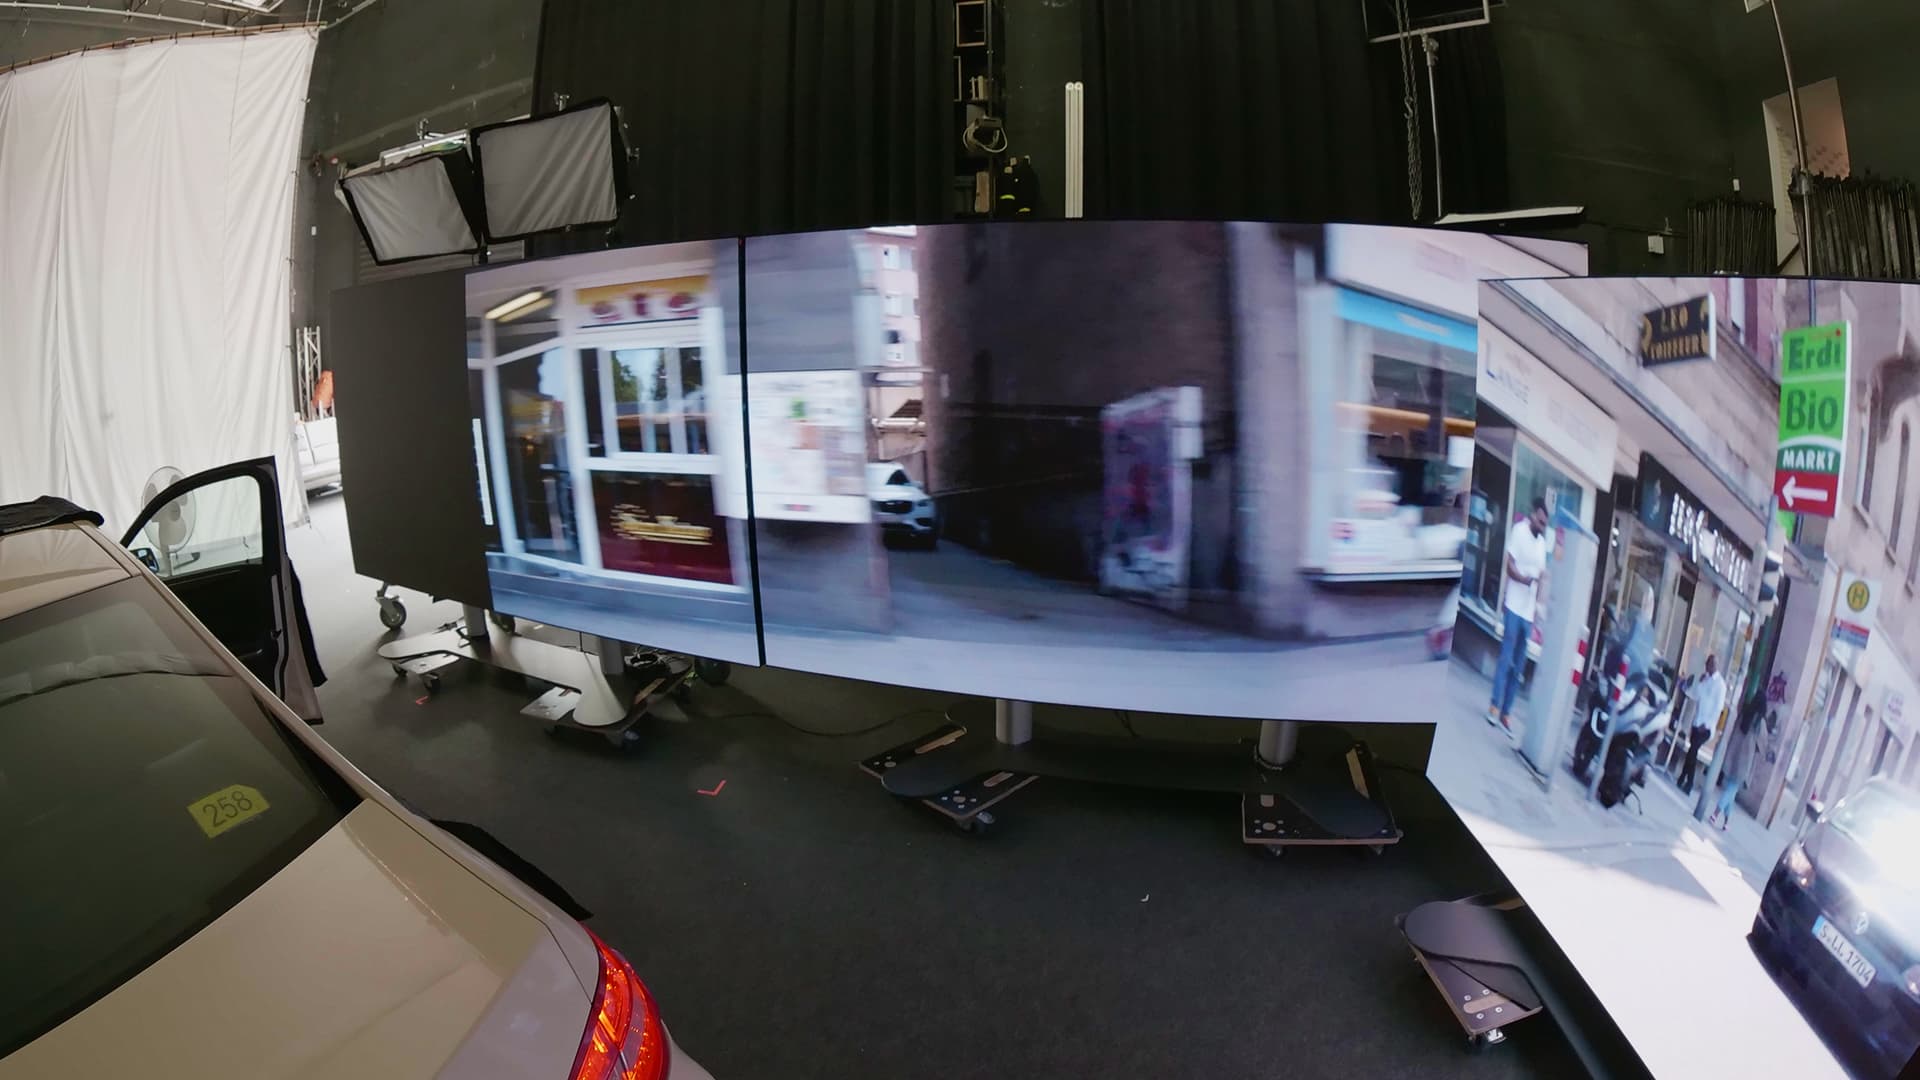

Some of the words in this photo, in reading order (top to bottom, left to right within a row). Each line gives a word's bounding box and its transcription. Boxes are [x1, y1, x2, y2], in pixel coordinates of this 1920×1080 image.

[1789, 337, 1841, 370] Erdi
[1785, 389, 1839, 432] Bio
[1782, 449, 1835, 471] MARKT
[202, 790, 253, 828] 258
[1846, 951, 1874, 982] 1704
